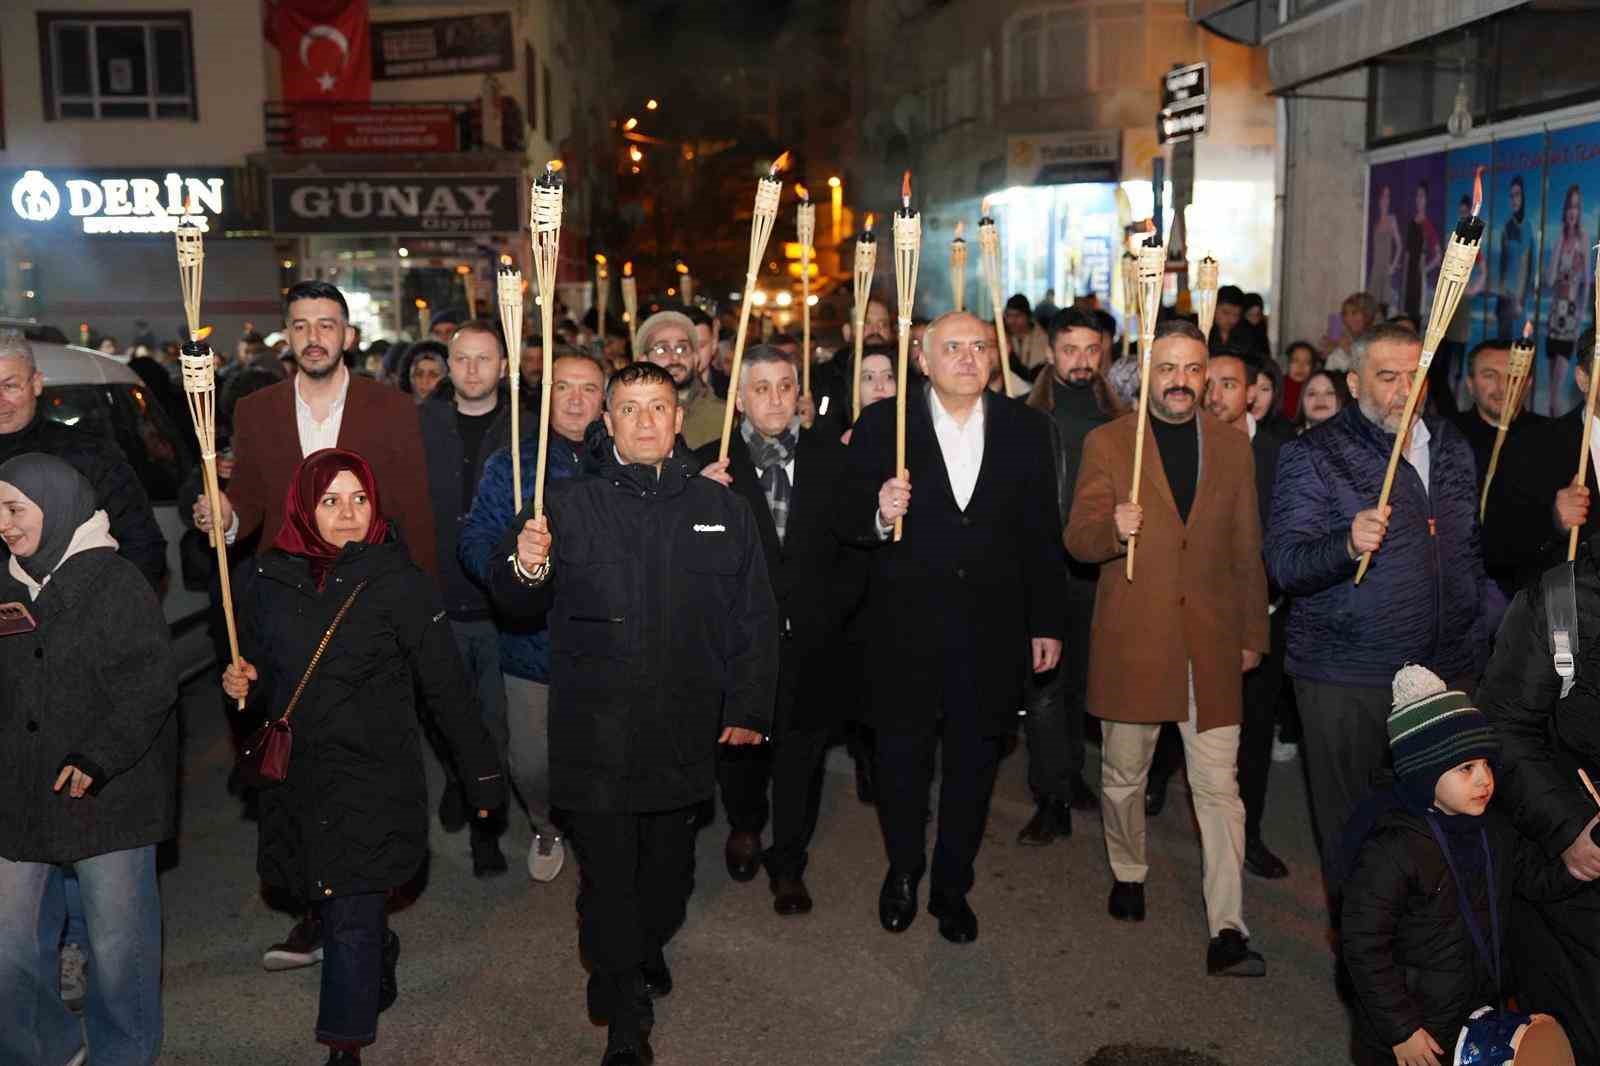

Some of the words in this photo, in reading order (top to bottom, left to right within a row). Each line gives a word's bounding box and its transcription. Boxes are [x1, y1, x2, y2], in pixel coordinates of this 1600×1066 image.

[66, 173, 224, 217] DERİN
[290, 182, 499, 218] GÜNAY
[421, 216, 492, 233] Giyim
